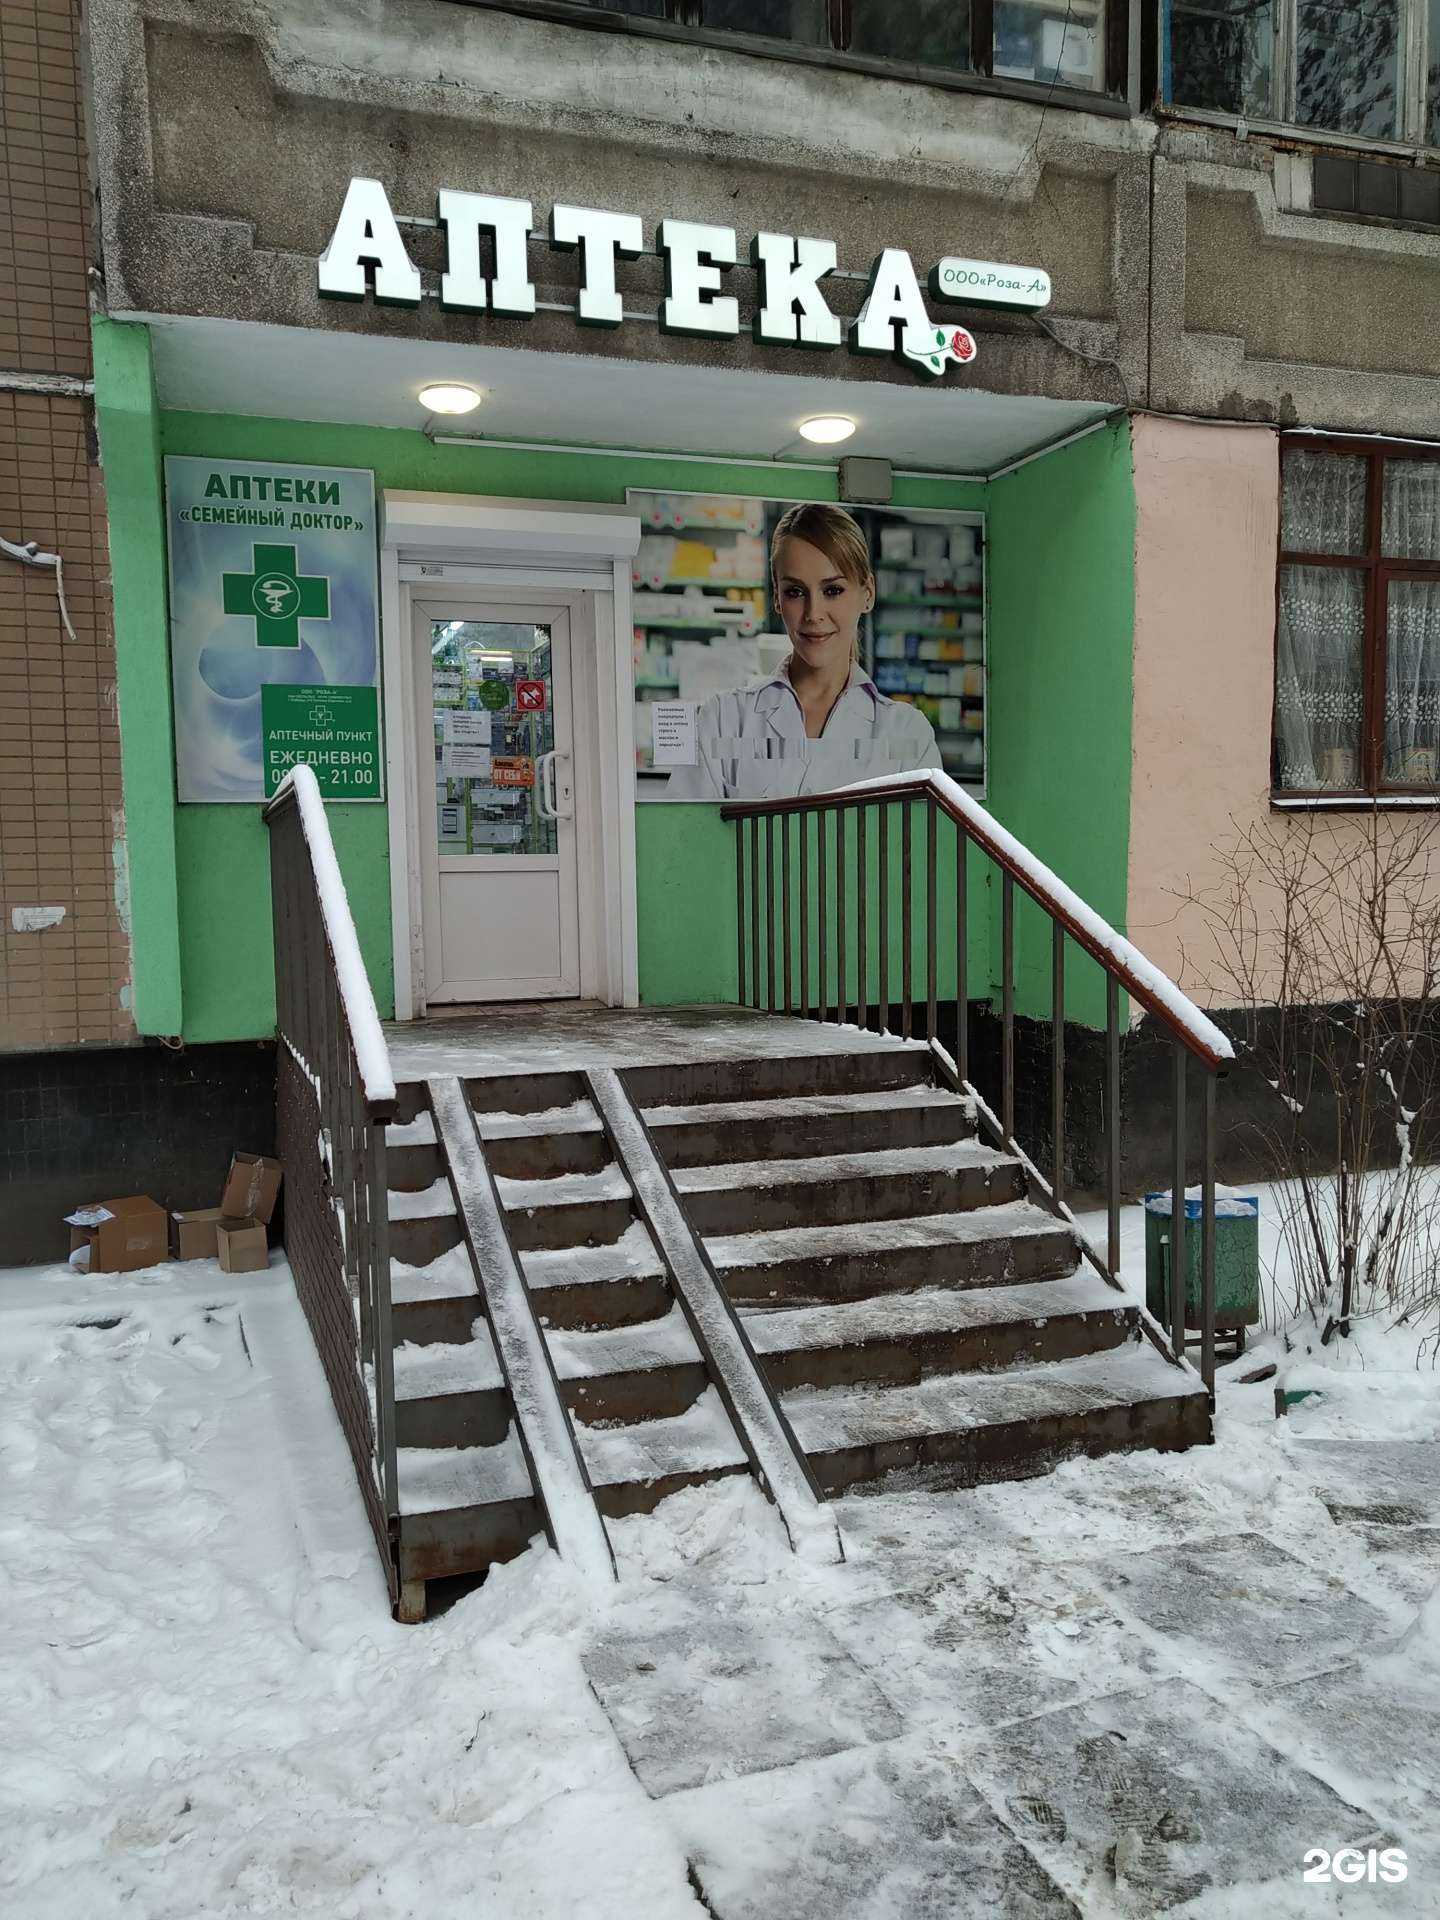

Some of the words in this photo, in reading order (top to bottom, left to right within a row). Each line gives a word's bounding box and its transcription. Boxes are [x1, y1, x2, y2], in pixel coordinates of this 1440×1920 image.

[318, 177, 952, 356] АПТЕКА
[204, 473, 341, 506] АПТЕКИ
[179, 504, 285, 527] «СЕМЕЙНЫЙ
[290, 511, 365, 531] ДОКТОР»
[269, 729, 334, 741] АПТЕЧНЫЙ
[336, 730, 373, 742] ПУНКТ
[270, 750, 373, 766] ЕЖЕДНЕВНО
[331, 769, 373, 785] 21.00
